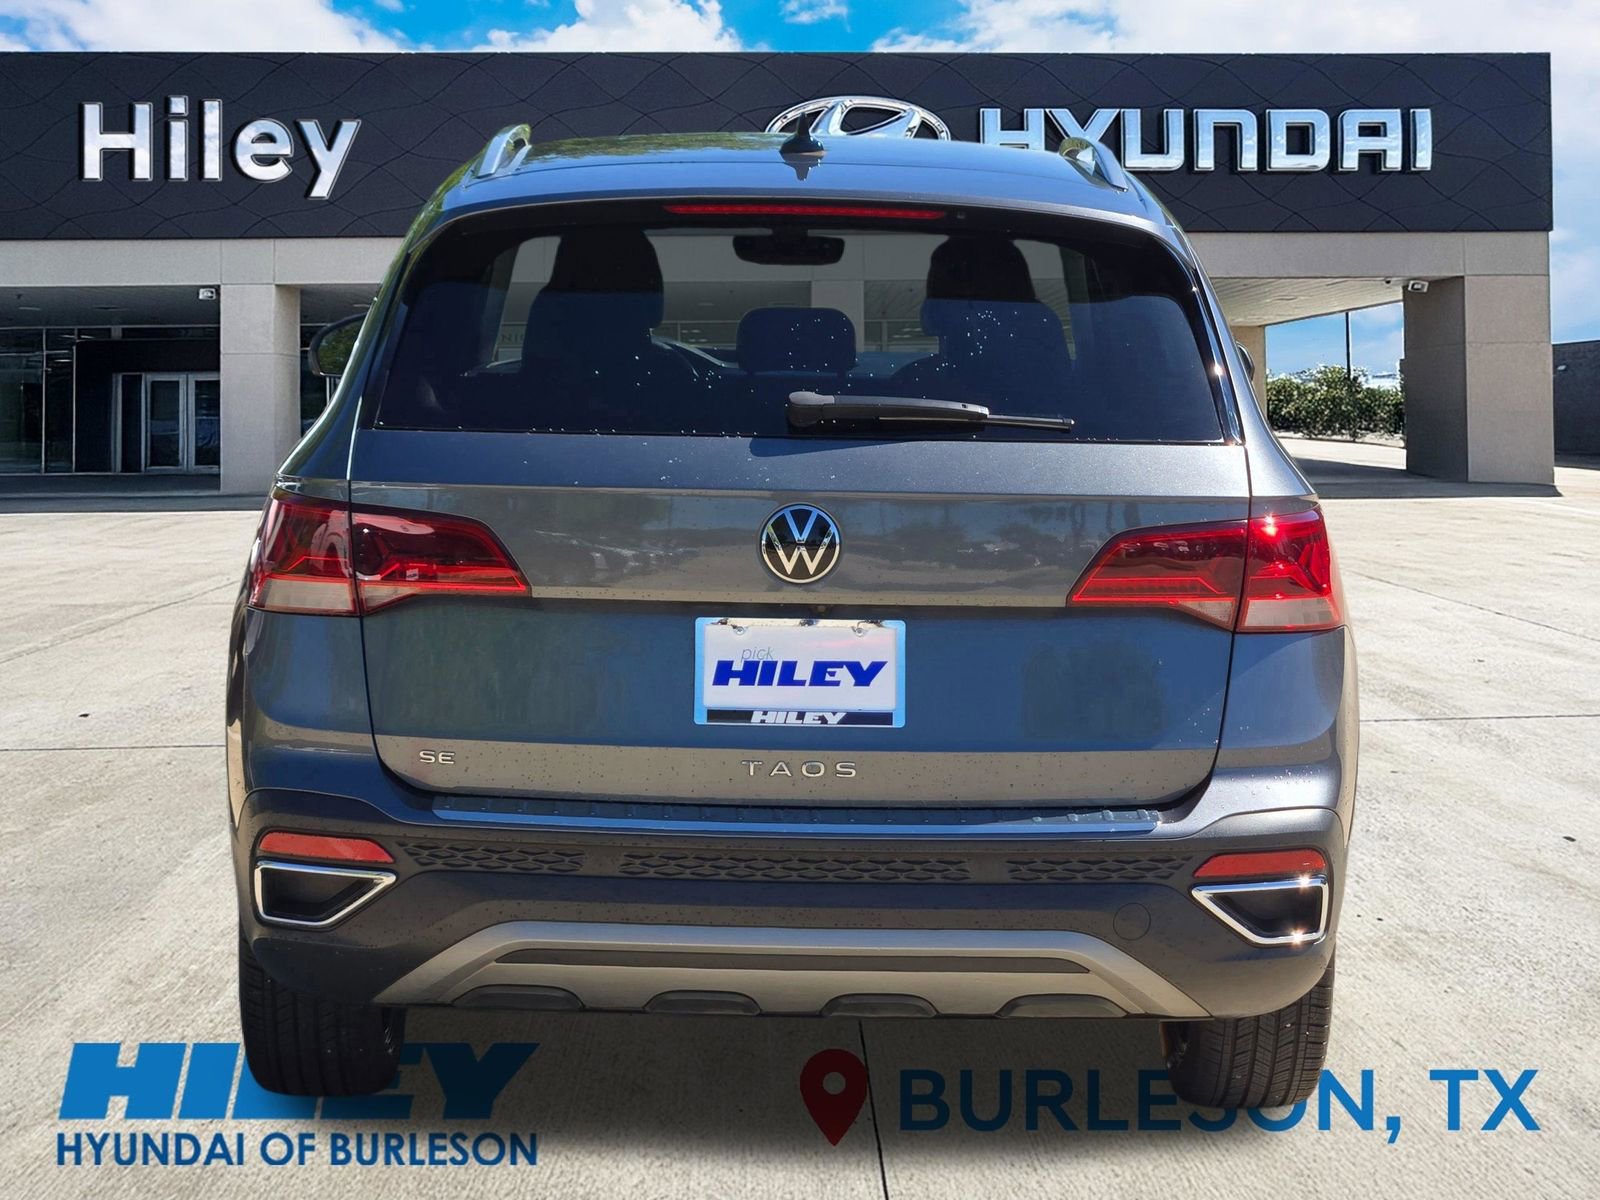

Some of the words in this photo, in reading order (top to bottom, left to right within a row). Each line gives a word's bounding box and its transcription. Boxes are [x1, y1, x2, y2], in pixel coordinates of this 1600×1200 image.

[80, 95, 361, 199] Hiley
[979, 107, 1433, 172] HYUNDAI
[741, 646, 775, 661] pick
[711, 660, 888, 687] HILEY
[750, 710, 848, 725] HILEY
[418, 750, 456, 765] SE
[741, 760, 857, 778] TAOS
